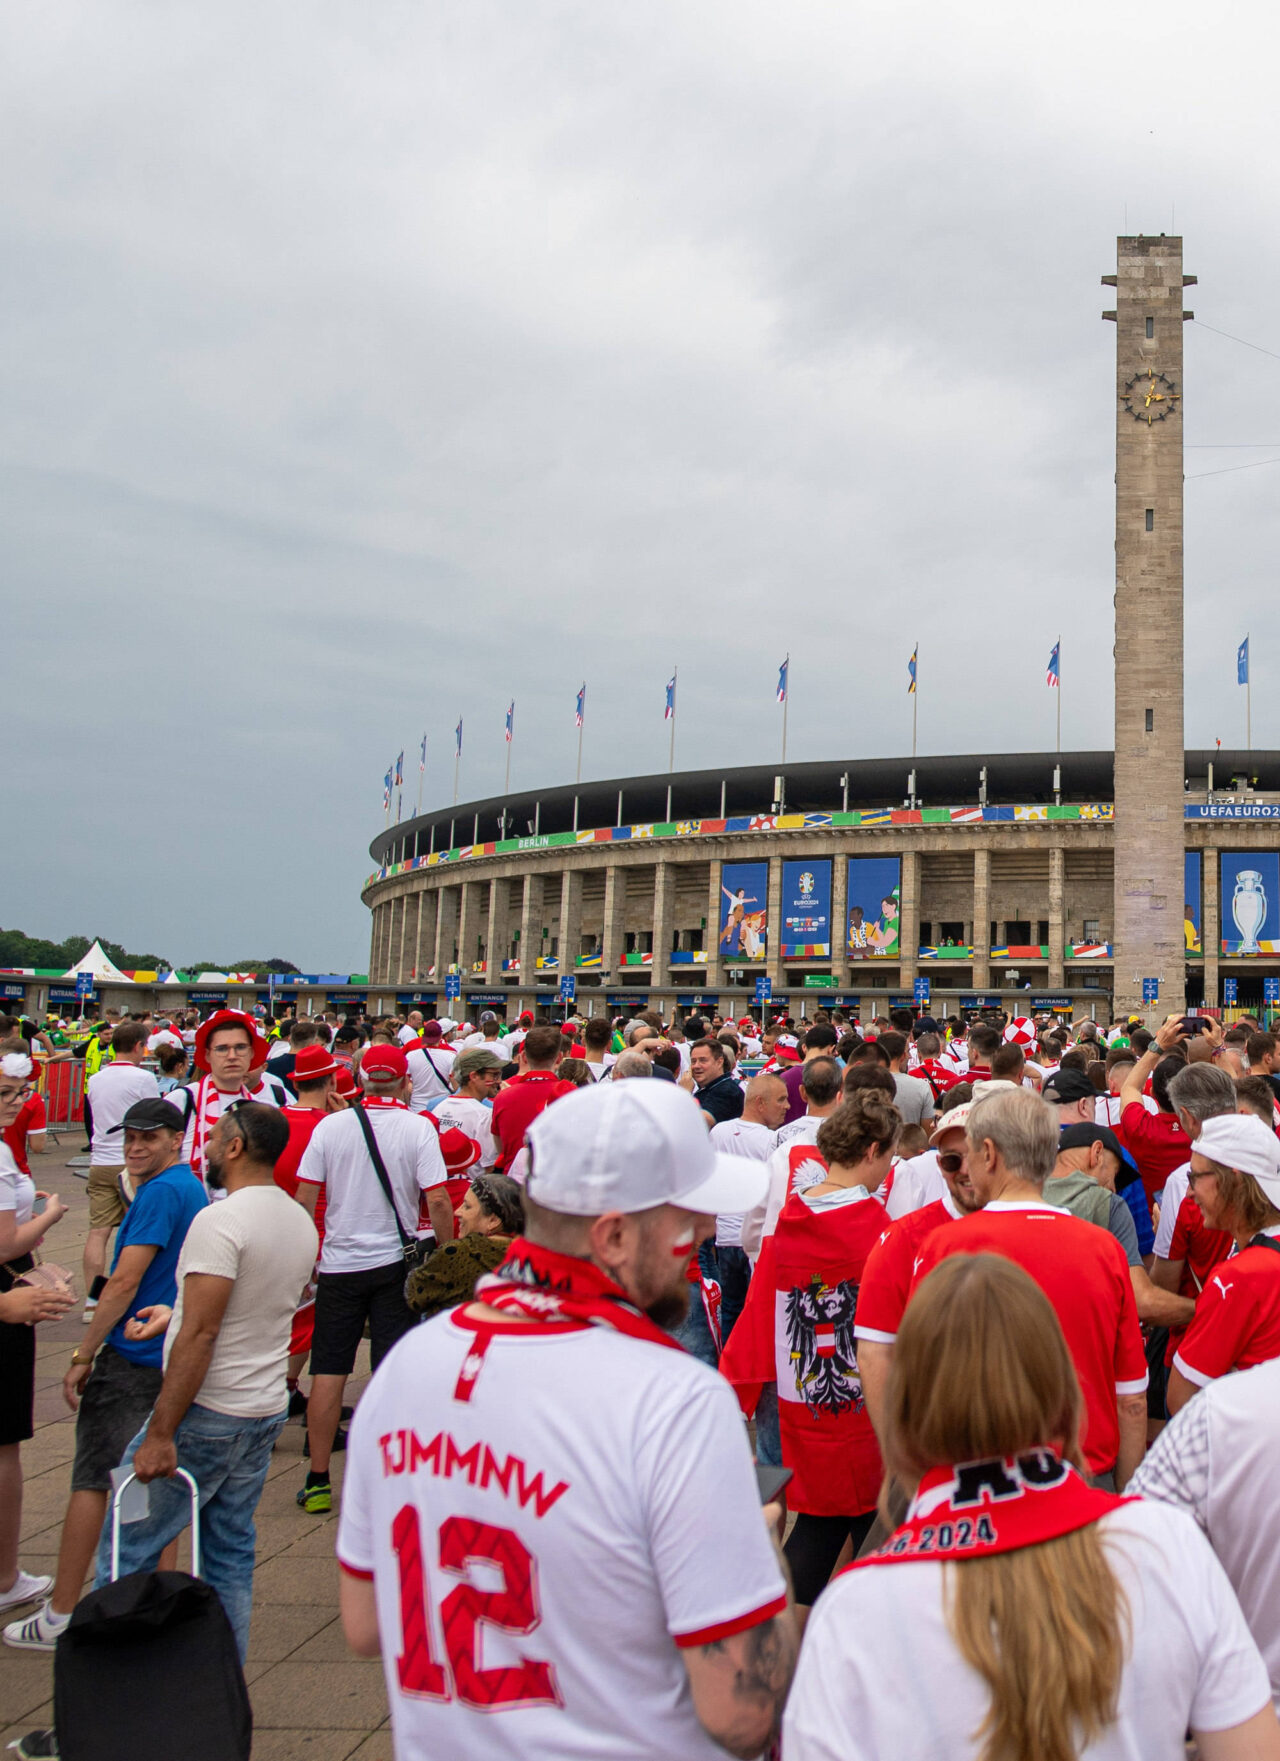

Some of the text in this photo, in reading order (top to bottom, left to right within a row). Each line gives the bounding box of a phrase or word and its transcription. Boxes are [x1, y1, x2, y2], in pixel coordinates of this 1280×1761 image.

[518, 837, 549, 849] BERLIN
[50, 989, 76, 998] ENTRANC
[390, 1502, 566, 1714] 12
